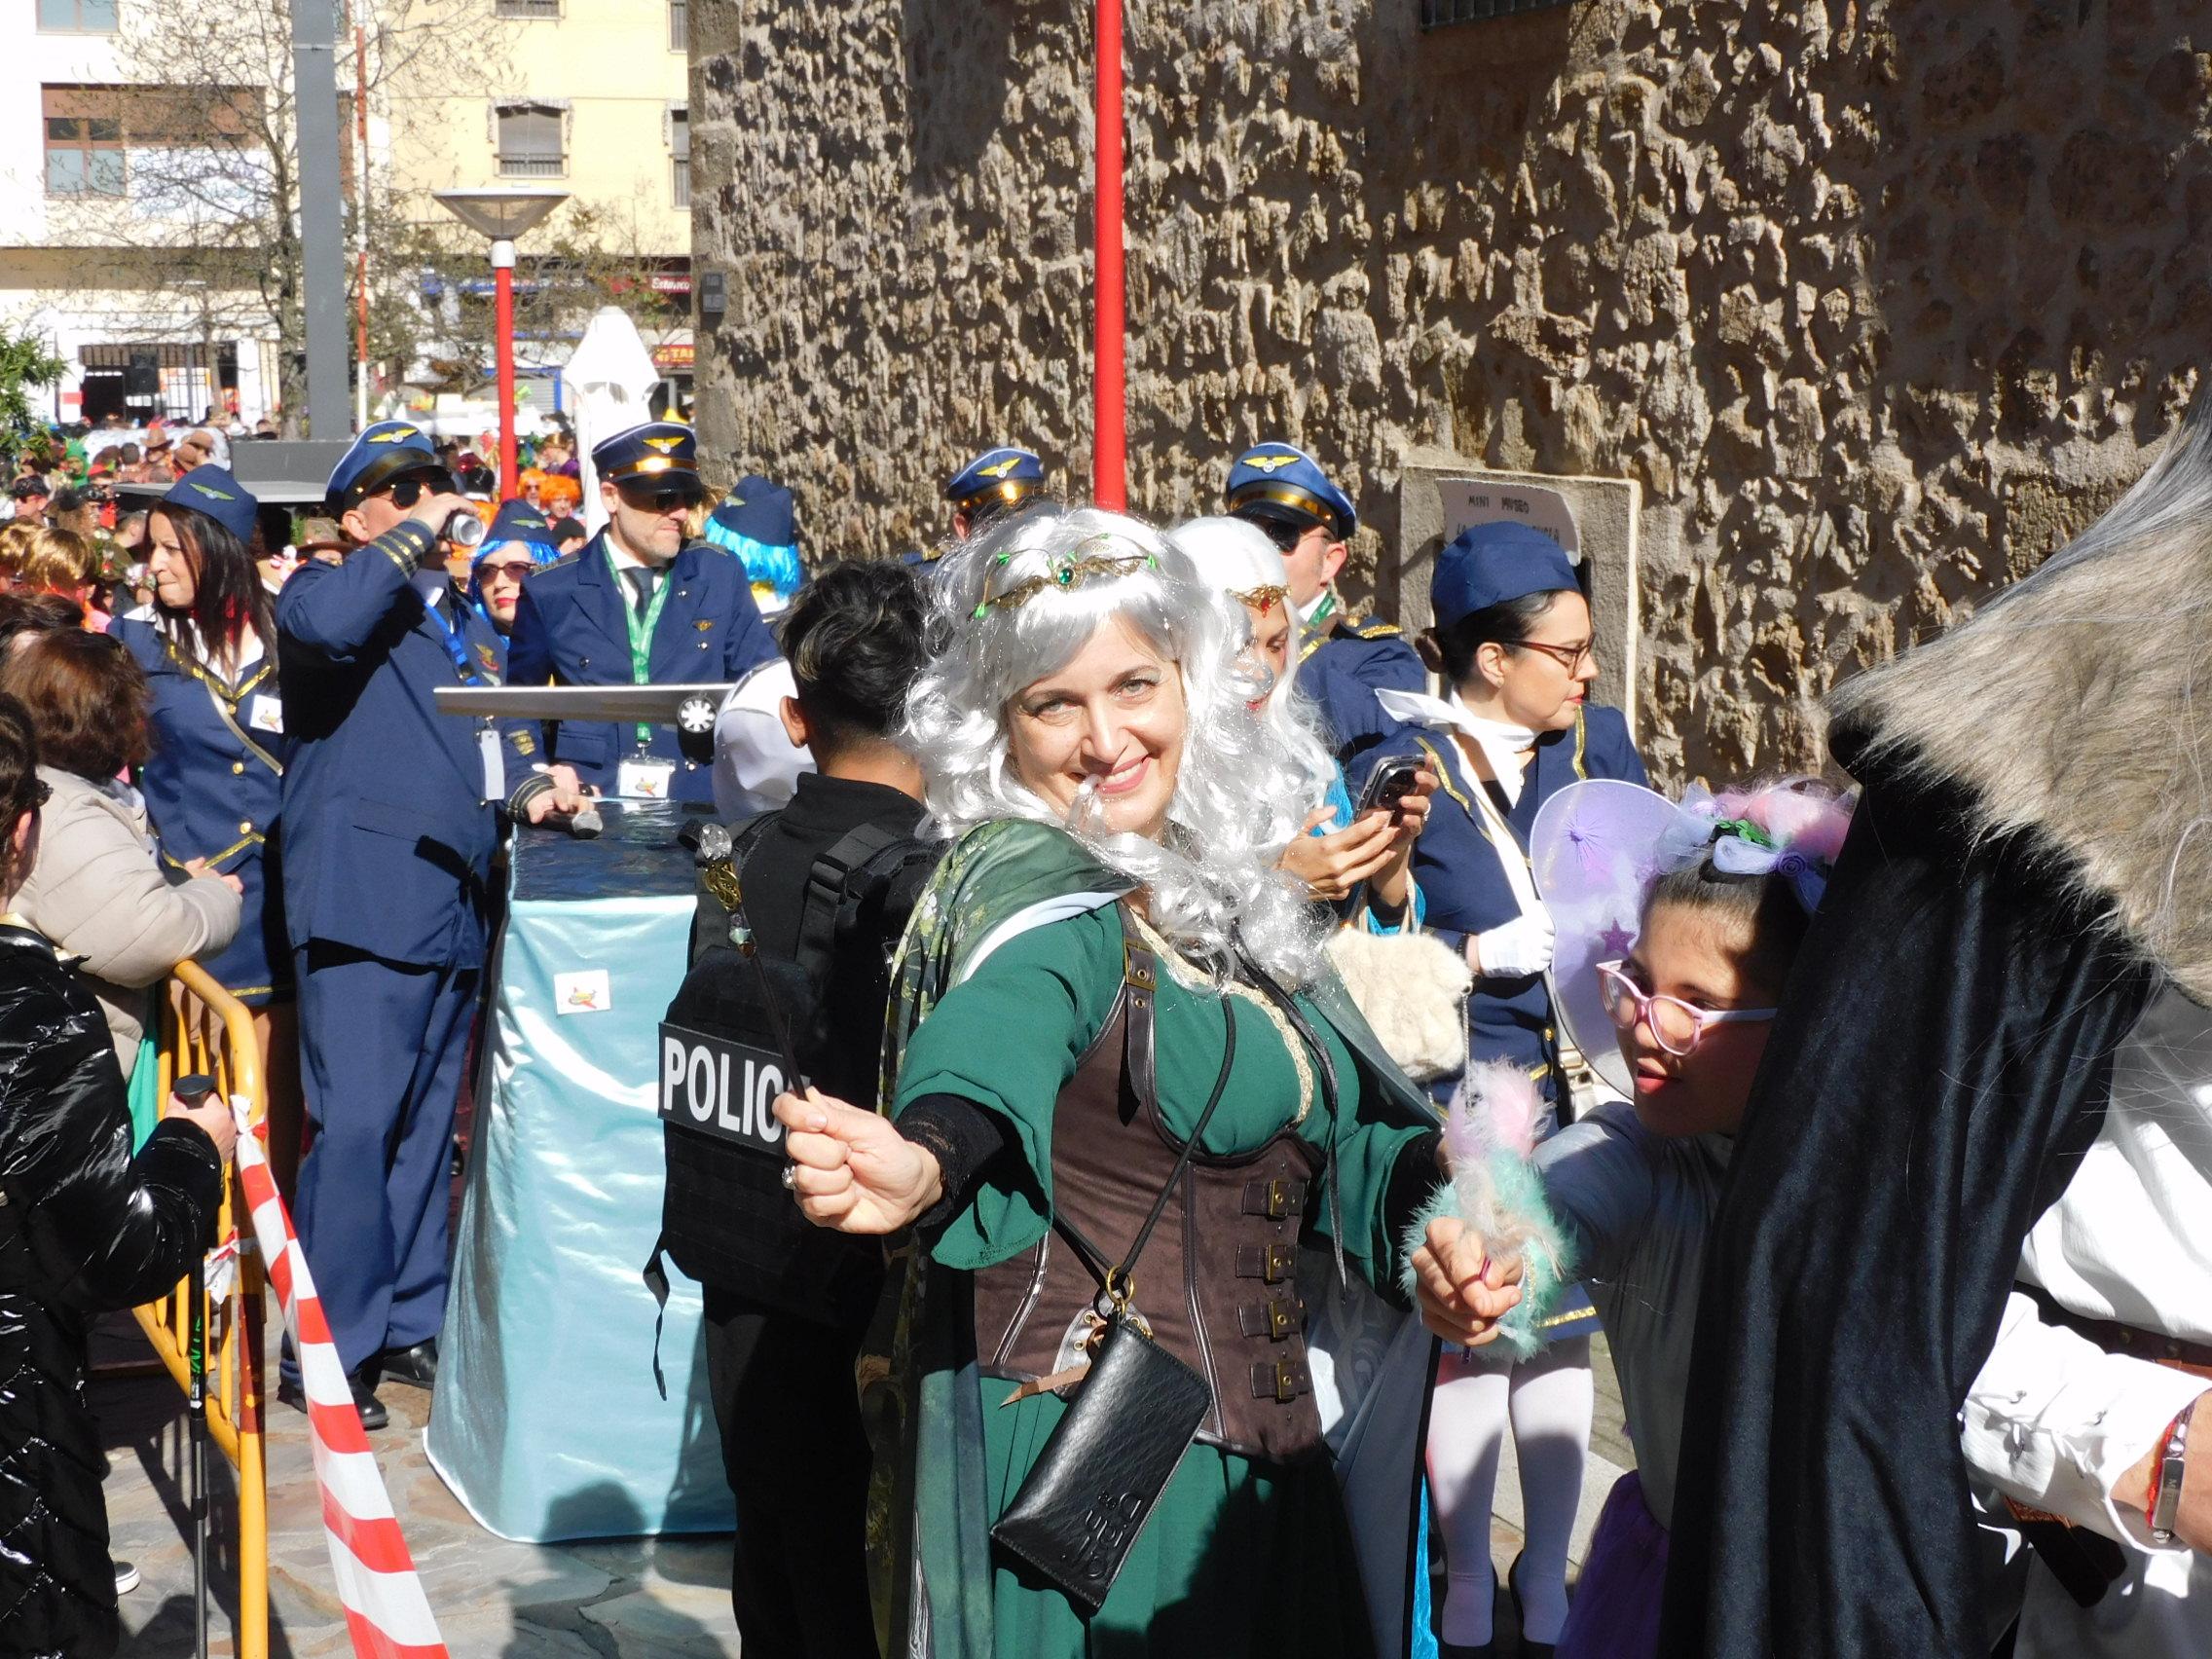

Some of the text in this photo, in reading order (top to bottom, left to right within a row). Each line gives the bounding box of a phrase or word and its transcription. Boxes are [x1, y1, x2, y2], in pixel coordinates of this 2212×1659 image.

[651, 277, 691, 290] Estanco
[1468, 496, 1490, 507] MINI
[664, 1037, 811, 1143] POLIC
